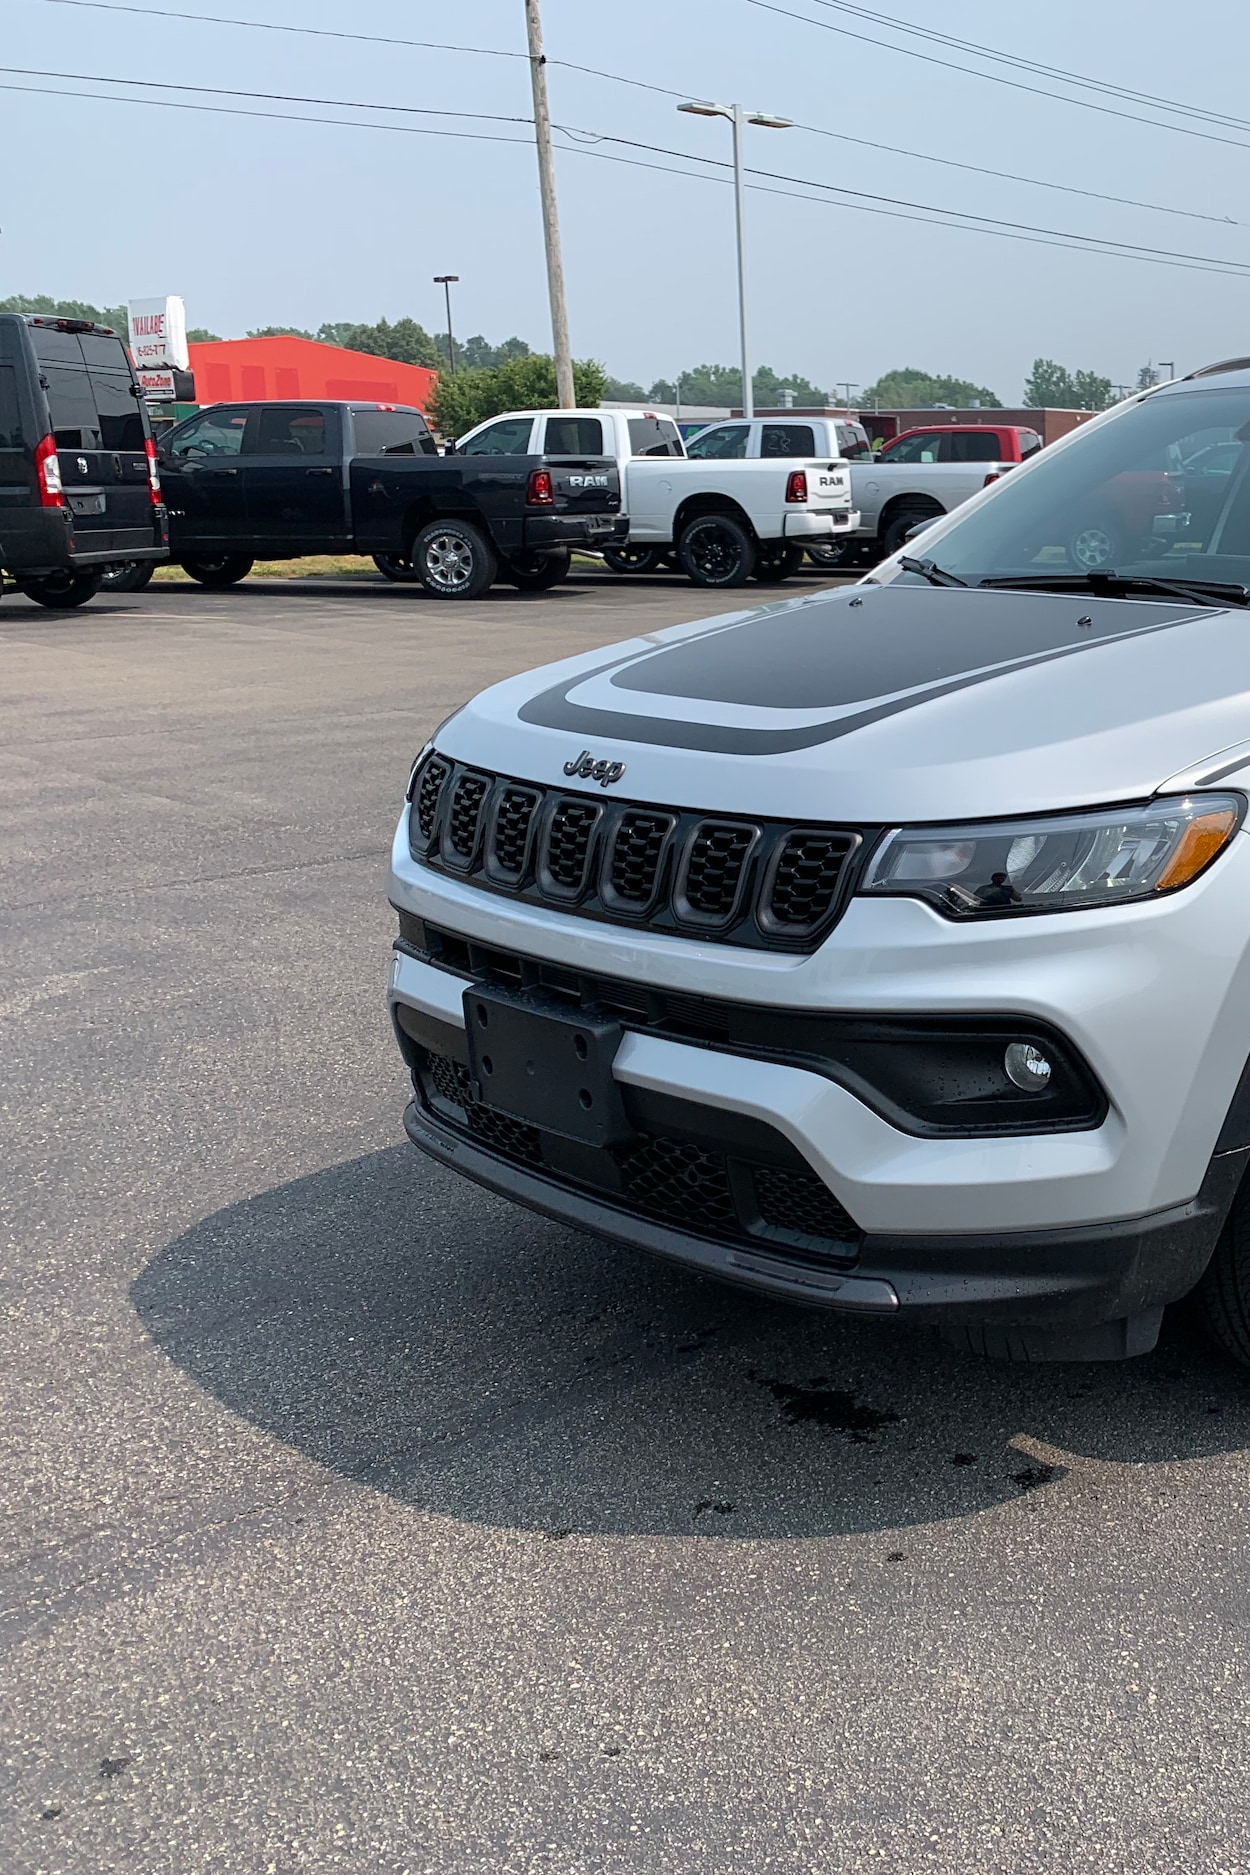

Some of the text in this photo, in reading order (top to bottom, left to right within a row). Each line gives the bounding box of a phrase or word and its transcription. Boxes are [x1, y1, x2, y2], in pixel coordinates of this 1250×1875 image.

[569, 475, 608, 487] RAM
[819, 476, 844, 487] RAM
[563, 750, 627, 788] Jeep
